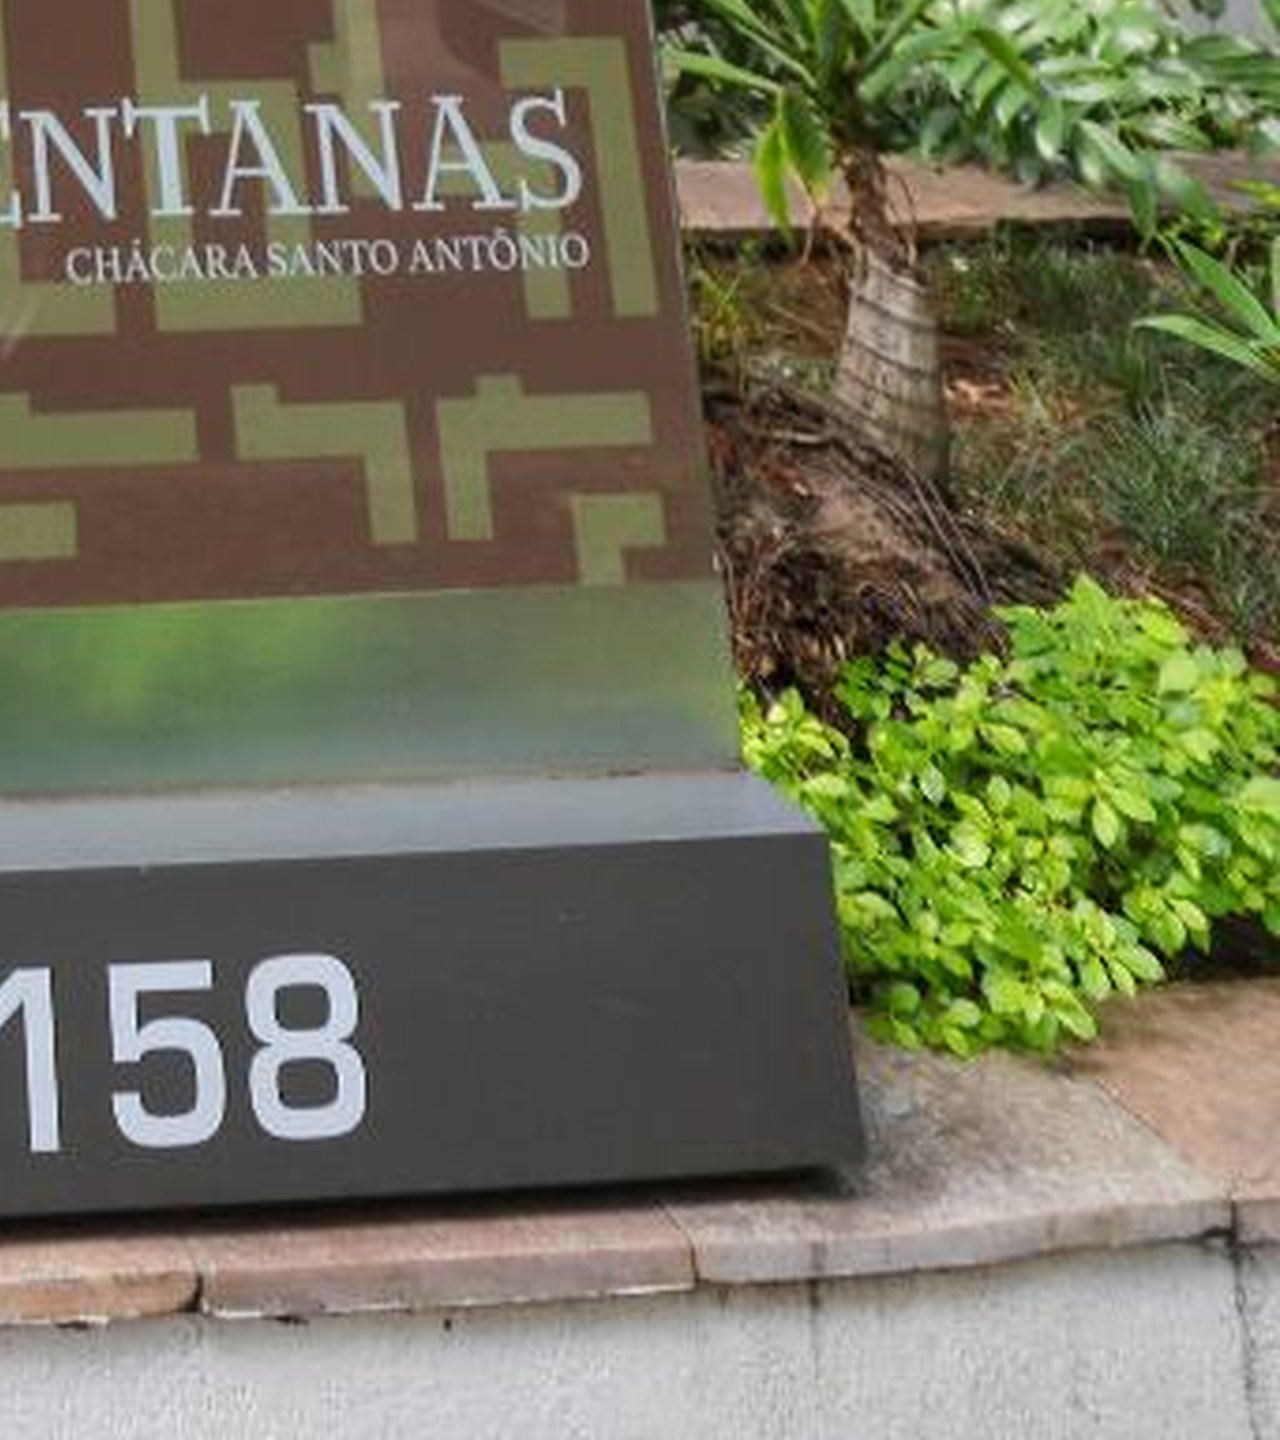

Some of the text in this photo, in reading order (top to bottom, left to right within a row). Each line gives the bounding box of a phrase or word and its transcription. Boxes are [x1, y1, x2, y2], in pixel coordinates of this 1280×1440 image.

[66, 228, 590, 285] CHÁCARA SANTO ANTÔNIO
